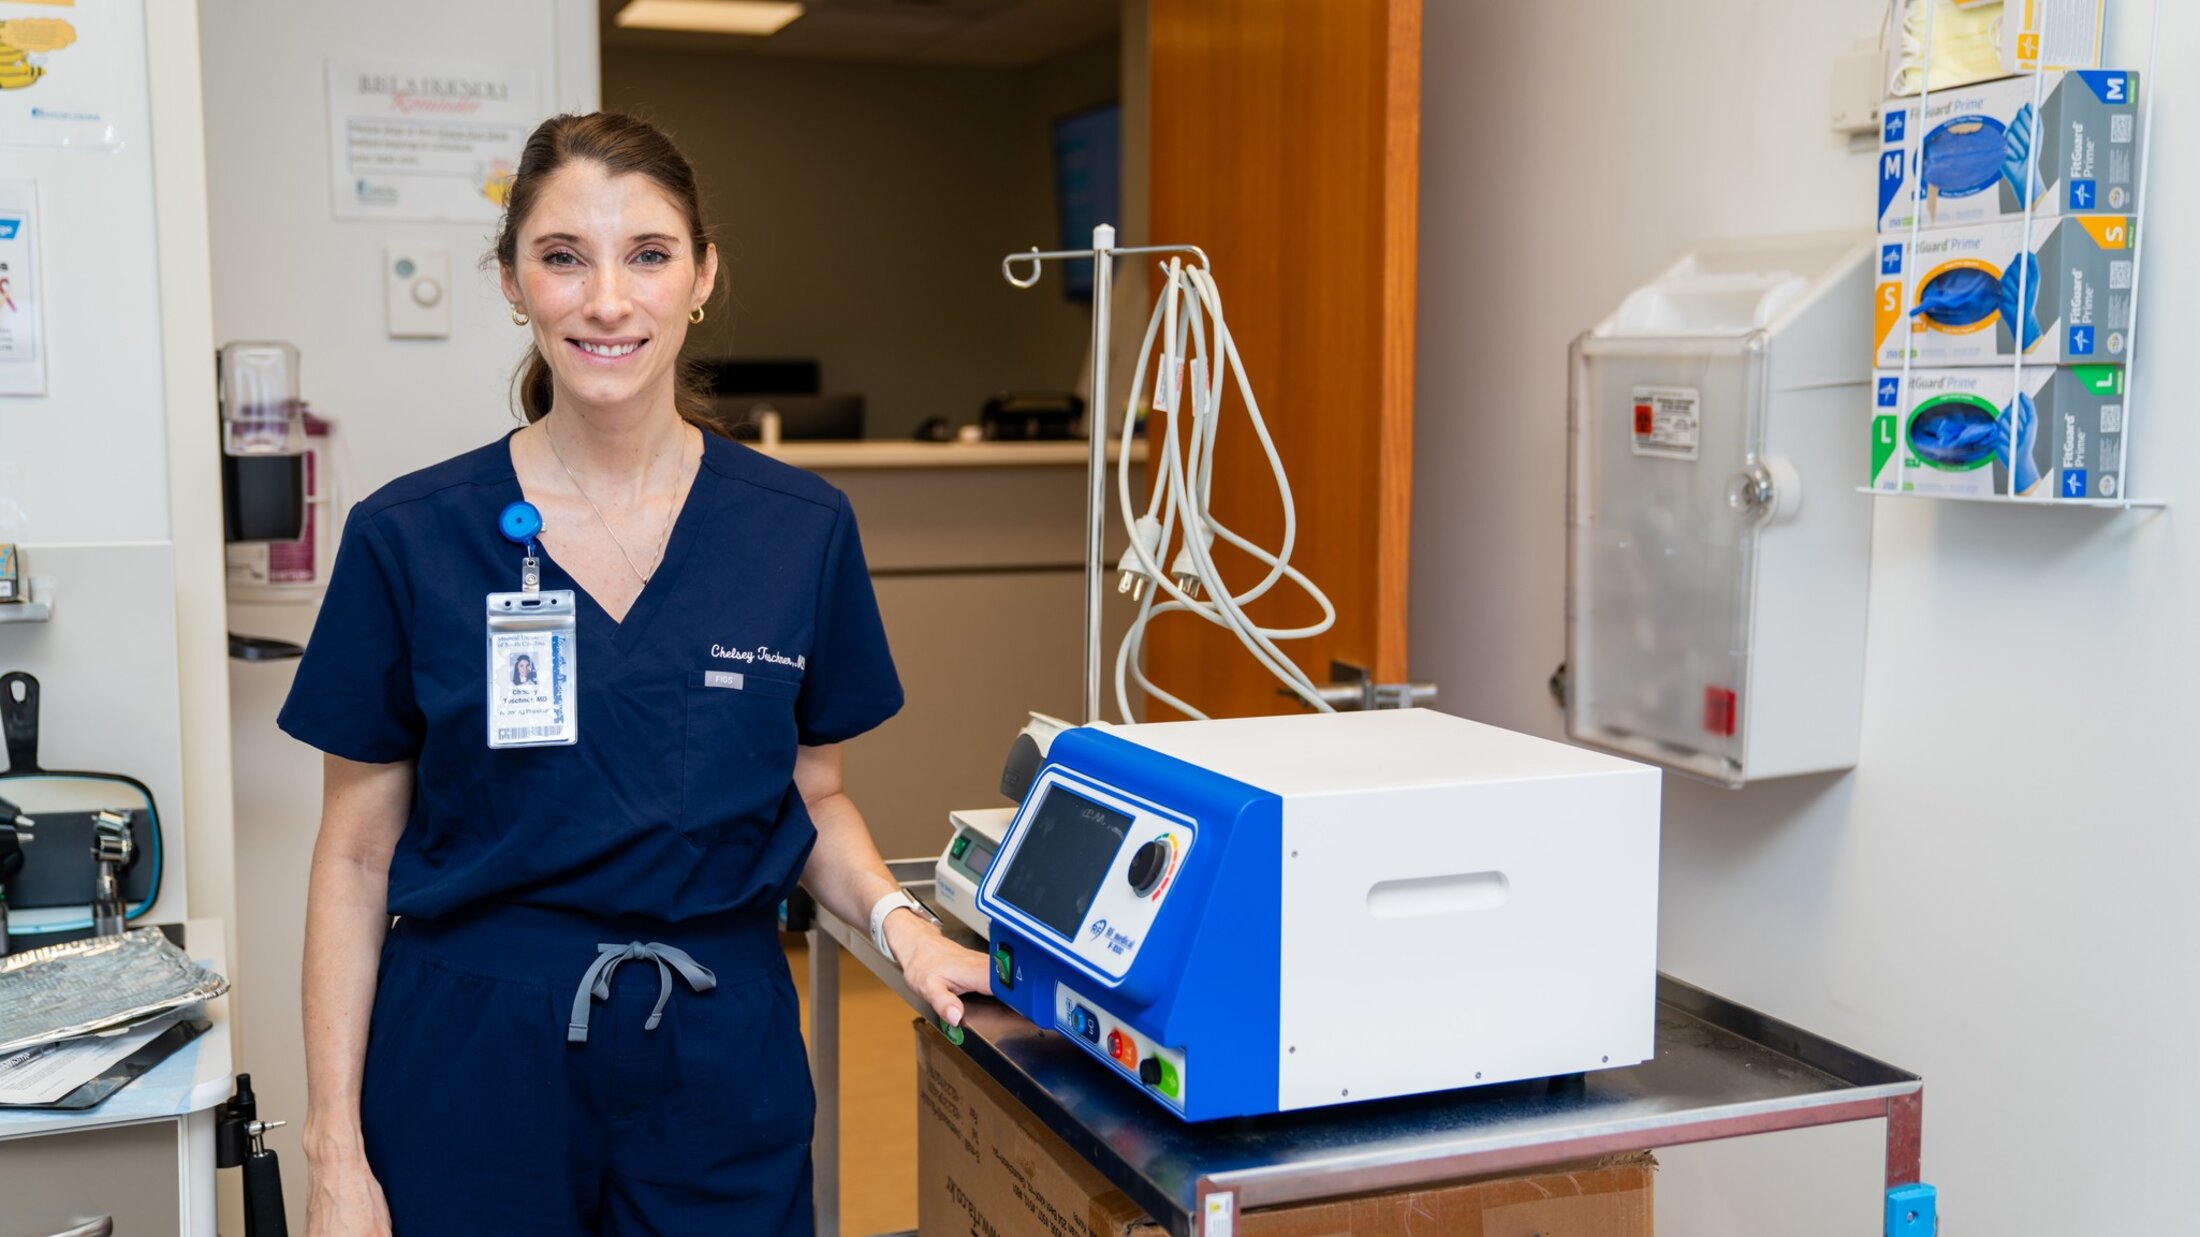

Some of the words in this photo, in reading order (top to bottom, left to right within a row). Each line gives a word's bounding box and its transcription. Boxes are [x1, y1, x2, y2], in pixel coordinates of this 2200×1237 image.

[2106, 78, 2124, 100] M
[1954, 98, 1984, 112] Prime
[2070, 121, 2084, 178] FitGuard
[2083, 138, 2095, 178] Prime
[1884, 153, 1901, 180] M
[1907, 240, 1948, 254] FtGuard
[1951, 238, 1982, 251] Prime
[2105, 226, 2123, 242] S
[1884, 287, 1896, 312] S
[2070, 267, 2083, 324] FitGuard
[2082, 284, 2094, 324] Prime
[1907, 376, 1945, 389] itGuard
[1947, 376, 1978, 389] Prime
[2096, 372, 2112, 387] L
[1881, 418, 1891, 444] L
[2063, 412, 2076, 468] FitGuard
[2074, 428, 2086, 468] Prime
[711, 643, 755, 664] Chelsey
[715, 675, 733, 684] FIGS
[946, 1175, 1001, 1237] ww.rfa.co.kr
